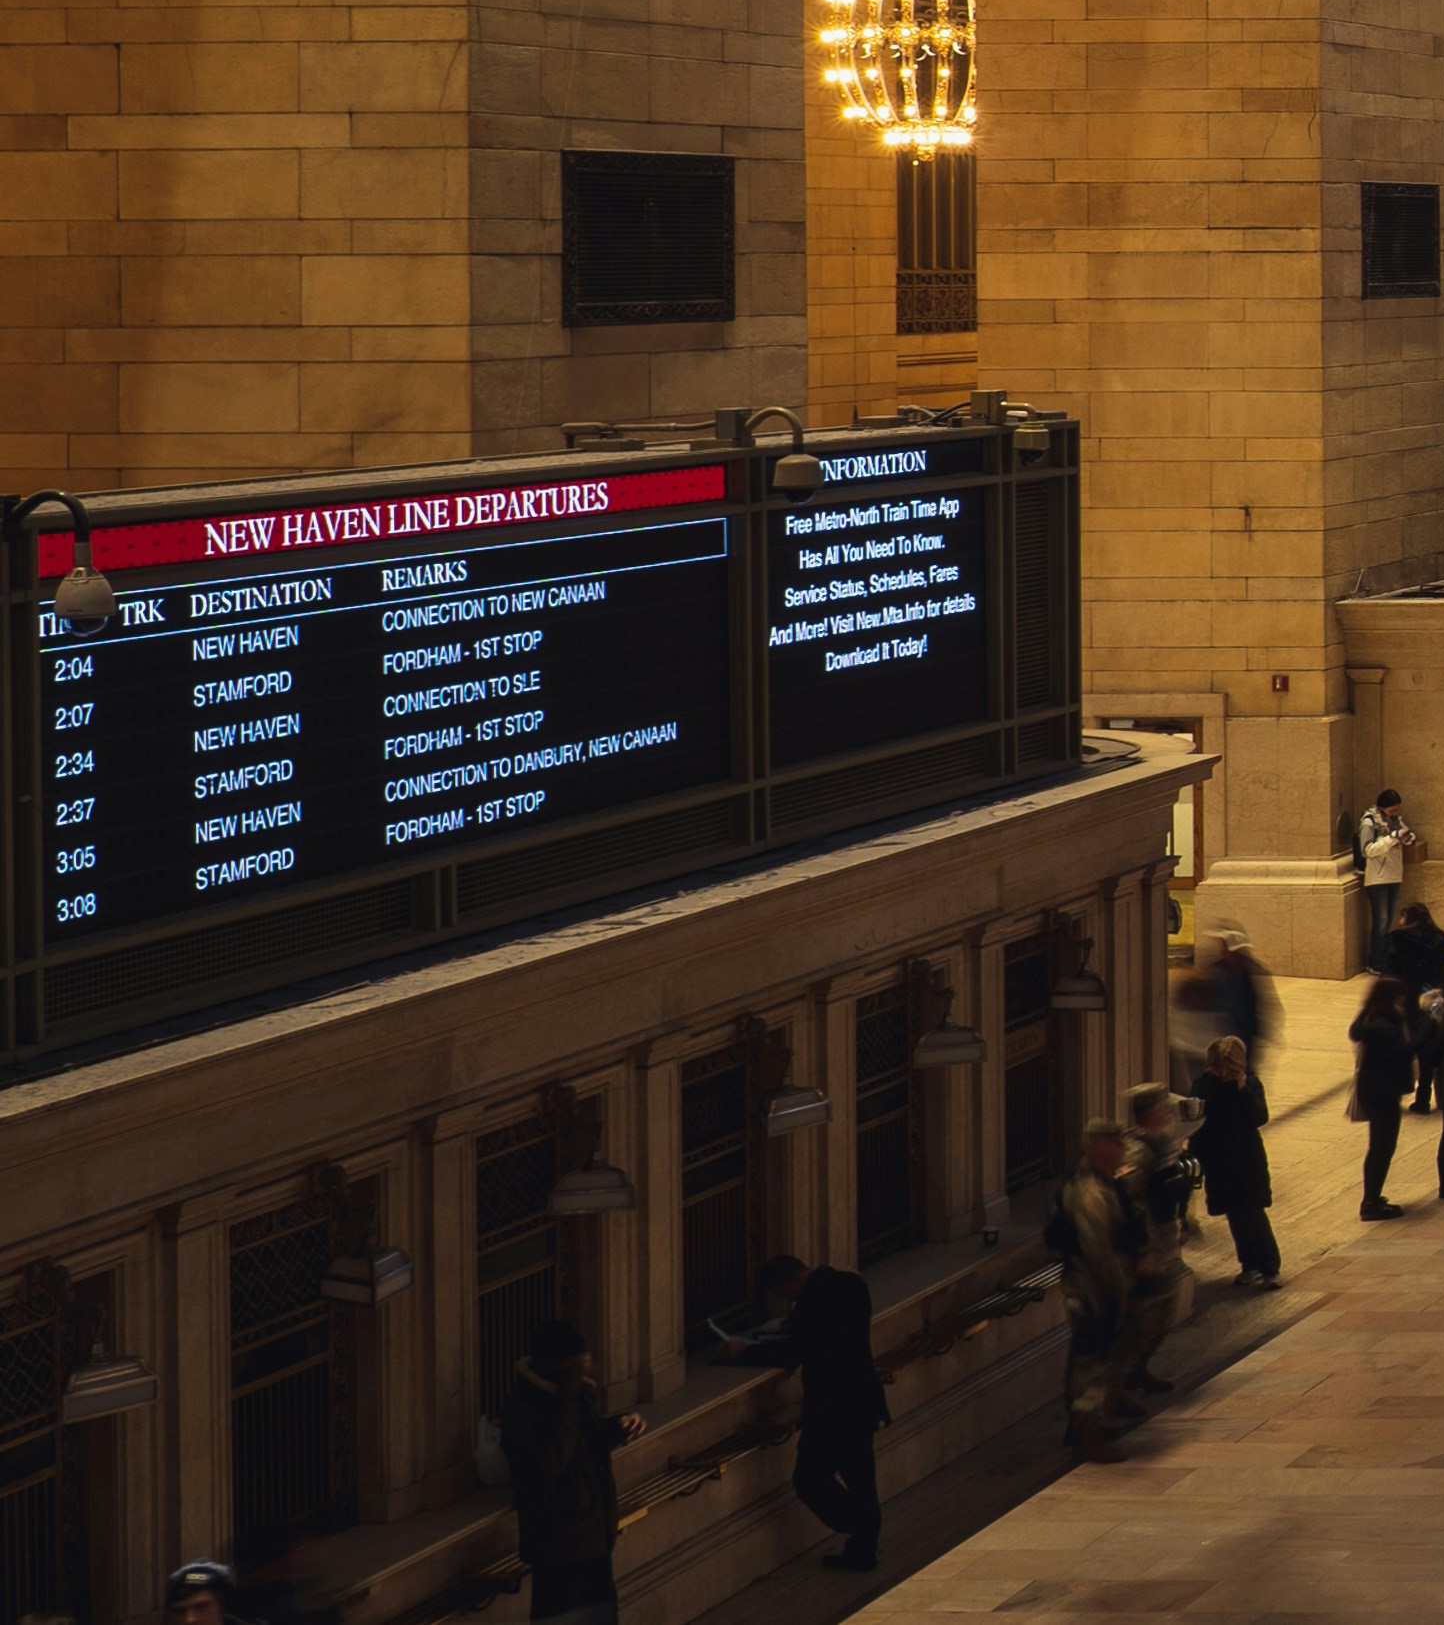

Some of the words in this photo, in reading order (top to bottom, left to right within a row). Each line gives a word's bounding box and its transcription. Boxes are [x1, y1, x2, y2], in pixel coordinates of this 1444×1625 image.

[820, 450, 927, 481] NFORMATION
[203, 516, 276, 556] NEW
[281, 505, 381, 547] HAVEN
[386, 498, 451, 534] LINE
[454, 481, 609, 527] DEPARTURES
[785, 515, 814, 536] Free
[814, 505, 881, 532] Metro-North
[880, 501, 910, 523] Train
[909, 499, 938, 519] Time
[938, 496, 960, 519] App
[798, 549, 823, 570] Has
[824, 545, 840, 566] All
[841, 542, 864, 563] You
[865, 537, 896, 560] Need
[895, 535, 912, 555] To
[912, 533, 946, 553] Know.
[118, 598, 166, 627] TRK
[189, 577, 332, 618] DESTINATION
[381, 559, 468, 592] REMARKS
[768, 623, 794, 647] And
[794, 617, 829, 642] More!
[829, 613, 855, 635] Visit
[855, 601, 926, 631] New.Mta.Info
[926, 599, 942, 618] for
[942, 592, 976, 615] details
[784, 584, 828, 608] Service
[829, 579, 868, 601] Status,
[869, 568, 928, 594] Schedules,
[929, 564, 959, 584] Fares
[54, 655, 94, 682] 2:04
[192, 633, 236, 662] NEW
[239, 625, 299, 654] HAVEN
[381, 598, 485, 632] CONNECTION
[486, 594, 509, 616] TO
[511, 589, 546, 613] NEW
[547, 580, 605, 608] CANAAN
[825, 642, 881, 672] Download
[881, 641, 891, 661] It
[890, 633, 928, 659] Today!
[54, 702, 95, 730] 2:07
[193, 670, 292, 708] STAMFORD
[383, 643, 461, 675] FORDHAM
[473, 636, 501, 660] 1ST
[503, 630, 542, 656] STOP
[55, 750, 95, 778] 2:34
[194, 724, 237, 753] NEW
[240, 713, 300, 744] HAVEN
[383, 680, 486, 718] CONNECTION
[487, 675, 510, 698] TO
[512, 670, 541, 694] SLE
[55, 797, 96, 826] 2:37
[194, 759, 293, 799] STAMFORD
[384, 725, 463, 760] FORDHAM
[475, 717, 503, 742] 1ST
[504, 710, 544, 737] STOP
[55, 845, 96, 874] 3:05
[195, 814, 238, 844] NEW
[241, 801, 302, 834] HAVEN
[384, 762, 488, 803] CONNECTION
[489, 757, 512, 779] TO
[514, 741, 587, 775] DANBURY,
[588, 733, 621, 758] NEW
[622, 721, 677, 751] CANAAN
[56, 892, 96, 922] 3:08
[195, 847, 295, 891] STAMFORD
[386, 808, 464, 845] FORDHAM
[475, 799, 504, 824] 1ST
[505, 790, 545, 818] STOP
